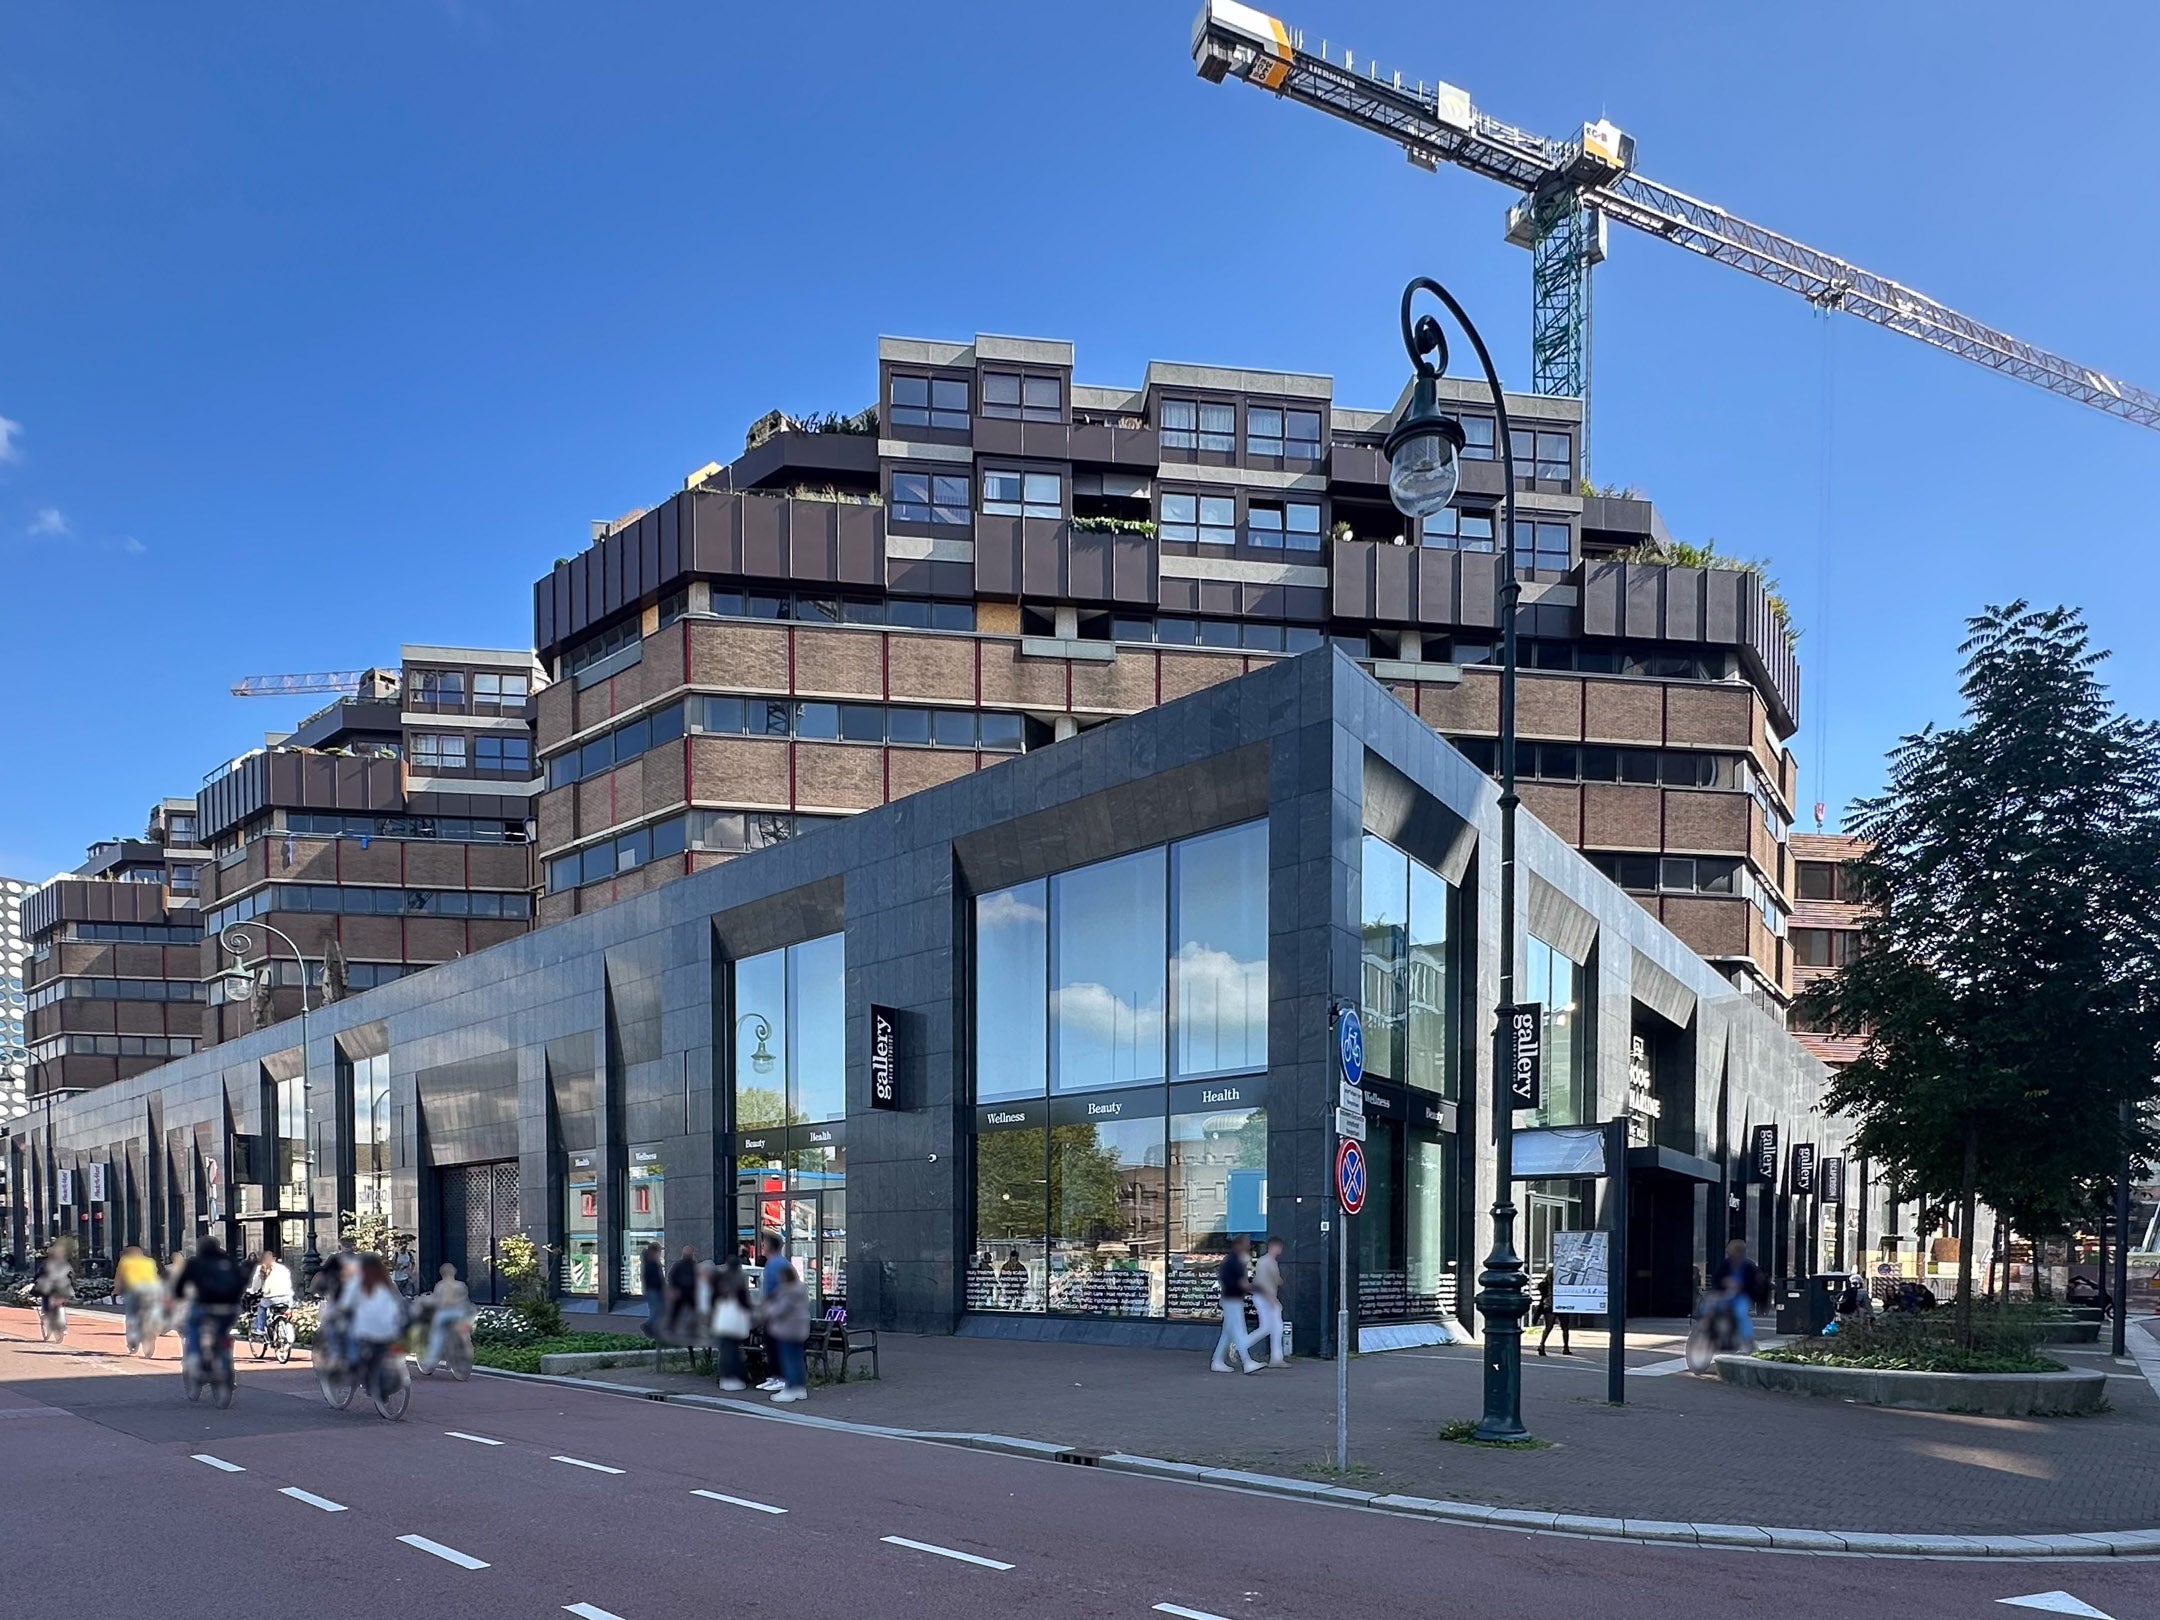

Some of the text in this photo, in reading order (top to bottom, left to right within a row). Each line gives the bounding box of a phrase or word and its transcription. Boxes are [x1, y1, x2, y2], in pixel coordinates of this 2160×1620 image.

[872, 1015, 892, 1100] gallery
[1512, 1014, 1539, 1099] gallery
[1202, 1088, 1240, 1103] Health
[1364, 1090, 1391, 1109] Wellness
[1087, 1102, 1122, 1115] Beauty
[987, 1112, 1026, 1125] Wellness
[745, 1138, 766, 1150] Beauty
[809, 1130, 832, 1142] Health
[1760, 1129, 1777, 1179] gallery
[1798, 1146, 1813, 1191] gallery
